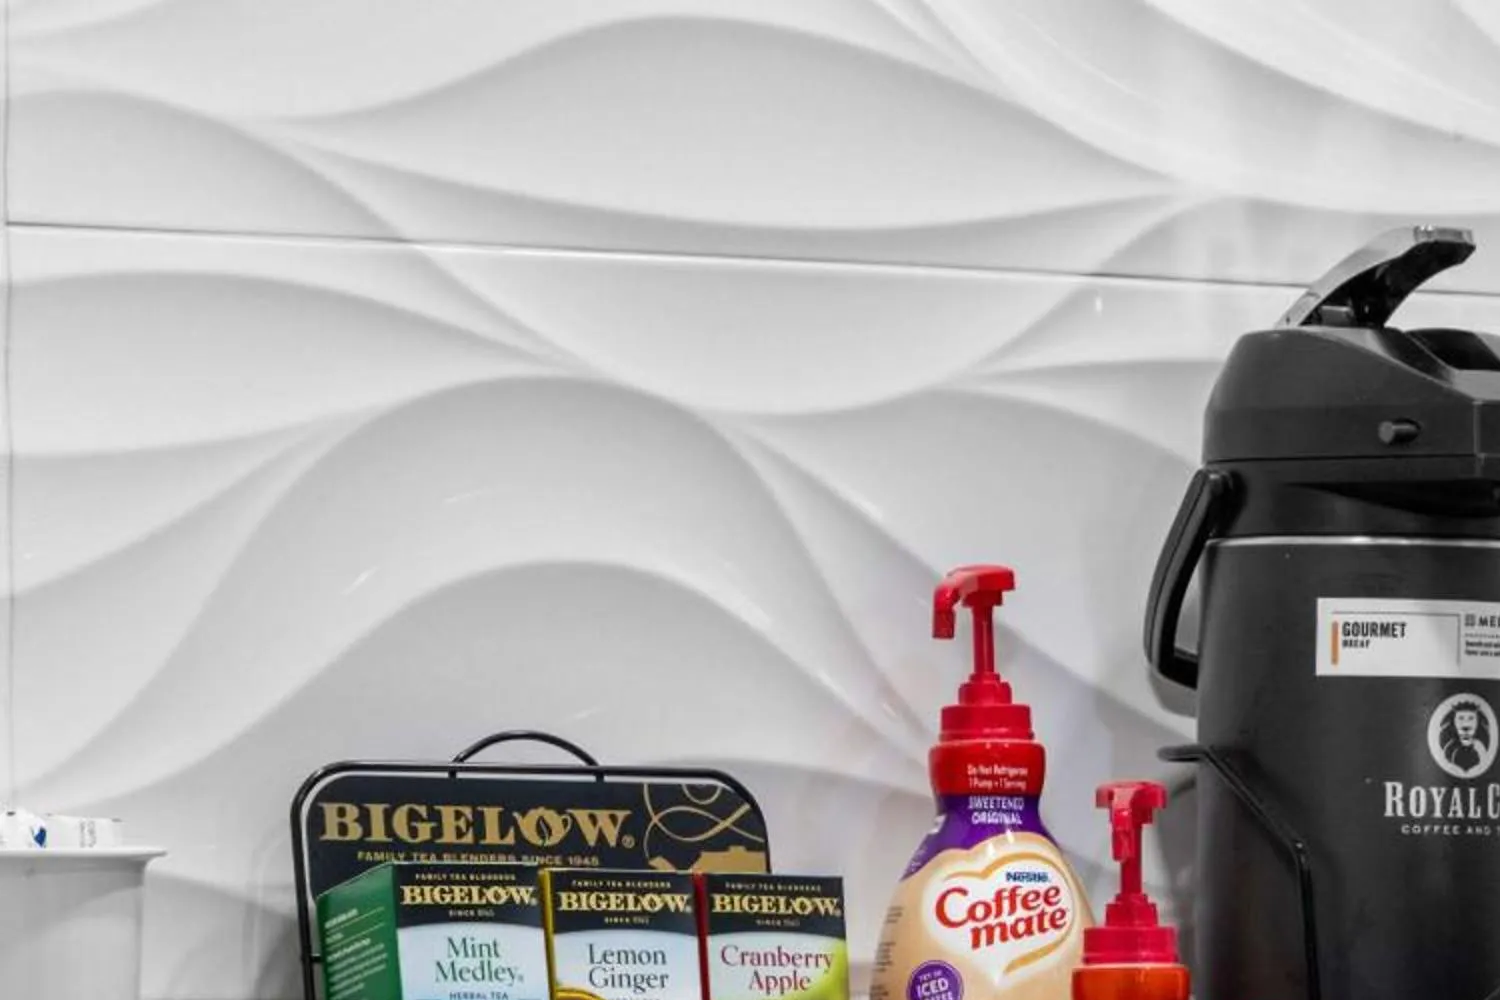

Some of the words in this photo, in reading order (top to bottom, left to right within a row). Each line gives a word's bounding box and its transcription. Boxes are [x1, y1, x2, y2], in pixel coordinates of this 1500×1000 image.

[1341, 621, 1407, 638] GOURMET
[968, 796, 1025, 810] SWEETENED
[1384, 781, 1482, 818] ROYAL
[319, 802, 632, 848] BIGELOW
[971, 810, 1023, 825] ORIGINAL
[1401, 824, 1461, 835] COFFEE
[1466, 825, 1491, 836] AND
[357, 851, 405, 862] FAMILY
[413, 852, 437, 863] TEA
[443, 853, 516, 864] BLENDERS
[401, 885, 535, 905] BIGELOW
[558, 891, 690, 912] BIGELOW
[711, 893, 838, 916] BIGELOW
[935, 886, 1062, 929] Coffee
[970, 907, 1067, 950] mate
[447, 937, 500, 959] Mint
[588, 944, 667, 965] Lemon
[720, 945, 833, 973] Cranberry
[435, 961, 518, 986] Medley
[588, 966, 669, 993] Ginger
[749, 969, 811, 995] Apple
[449, 991, 487, 1000] HERBAL
[491, 991, 509, 1000] TEA
[916, 978, 949, 998] ICED
